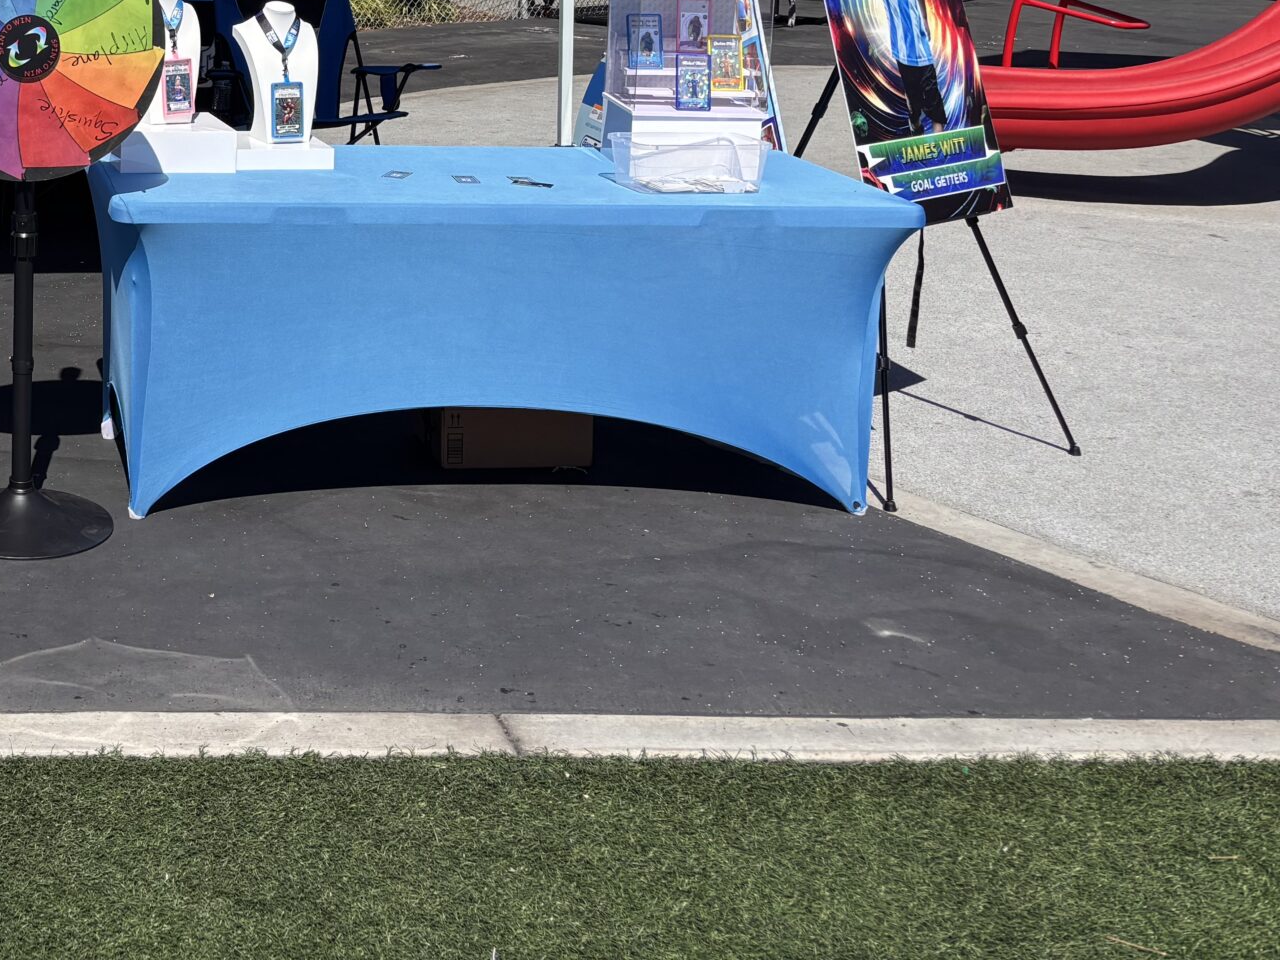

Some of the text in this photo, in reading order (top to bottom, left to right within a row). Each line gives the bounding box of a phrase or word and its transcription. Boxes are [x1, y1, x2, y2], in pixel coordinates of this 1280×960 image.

[14, 16, 32, 27] WIN
[50, 38, 58, 60] SPIN
[64, 26, 148, 67] Airplane
[24, 68, 42, 78] WIN
[900, 135, 968, 165] JAMES WITT
[910, 170, 969, 194] GOAL GETTERS
